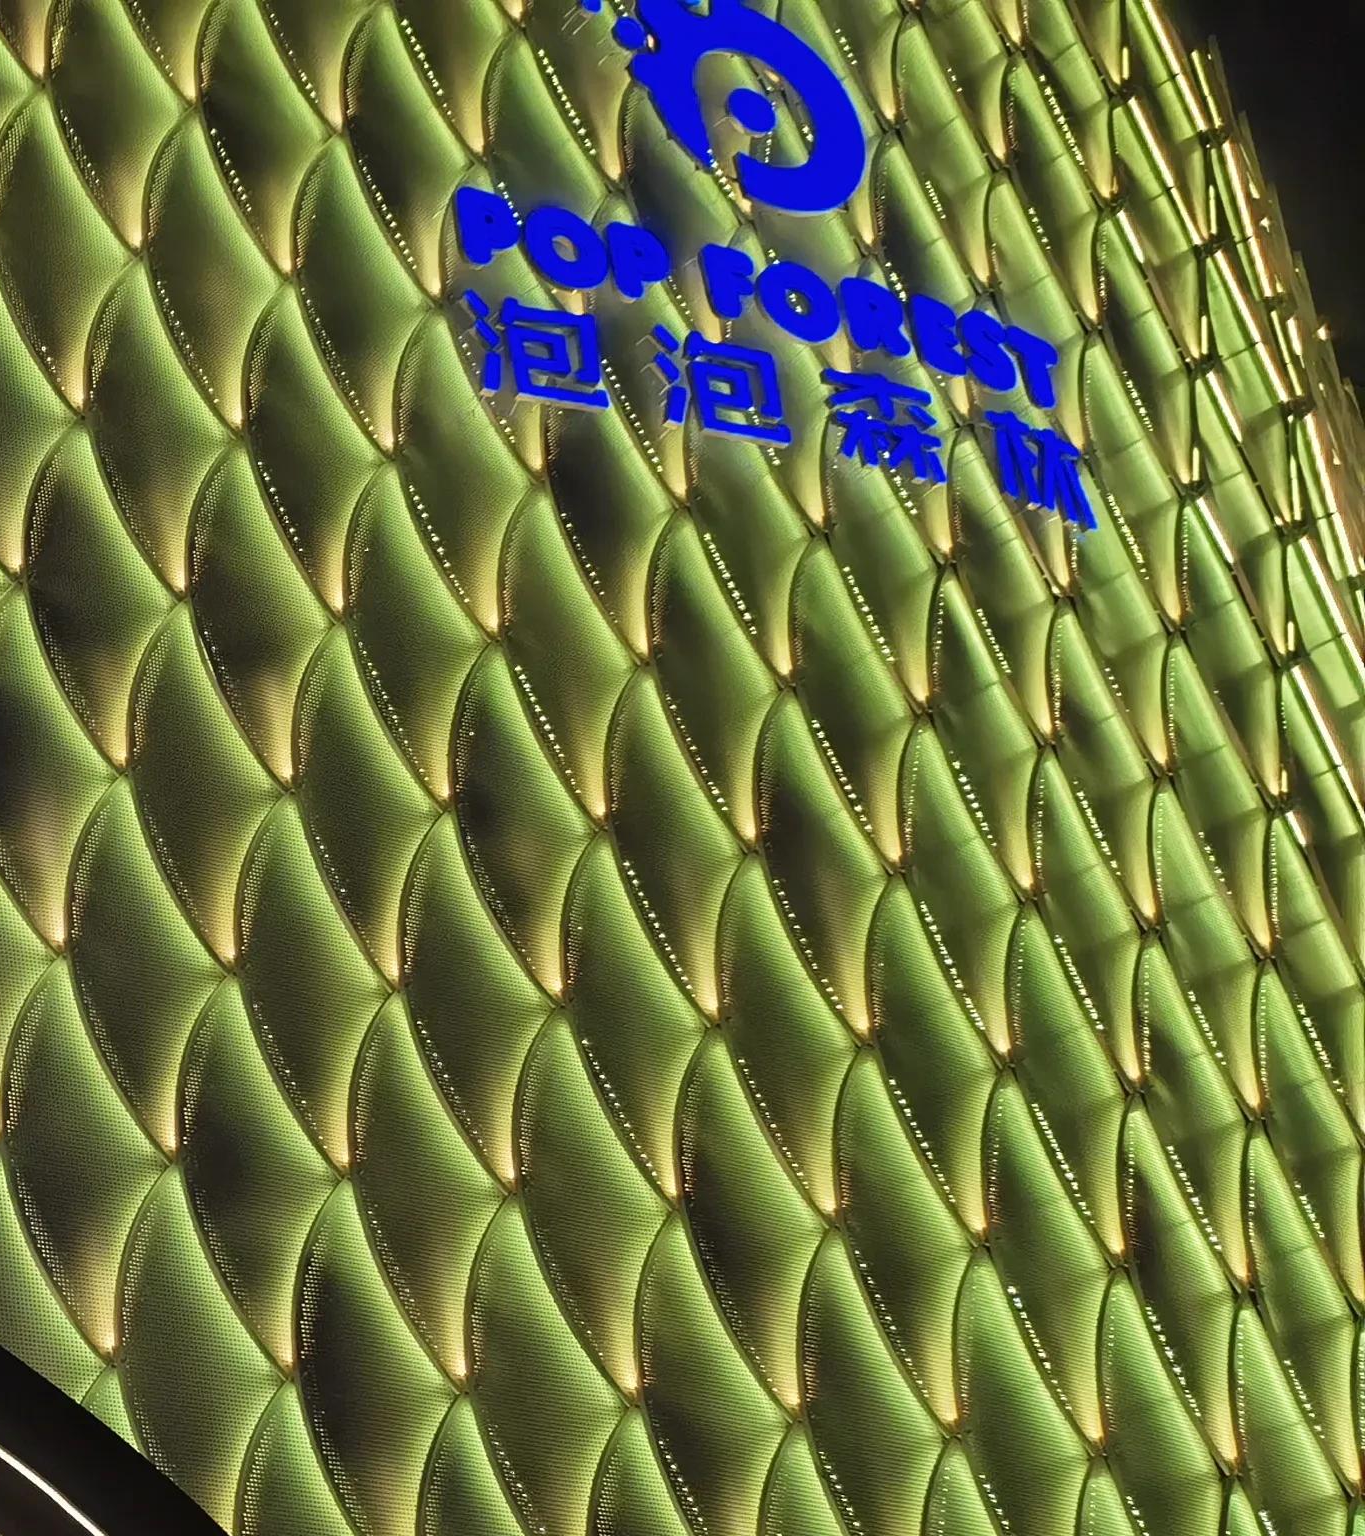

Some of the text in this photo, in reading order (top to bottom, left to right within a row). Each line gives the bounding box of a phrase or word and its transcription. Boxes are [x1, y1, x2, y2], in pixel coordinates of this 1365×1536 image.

[455, 187, 1061, 409] POP FOREST
[461, 287, 1098, 531] 泡泡森林
